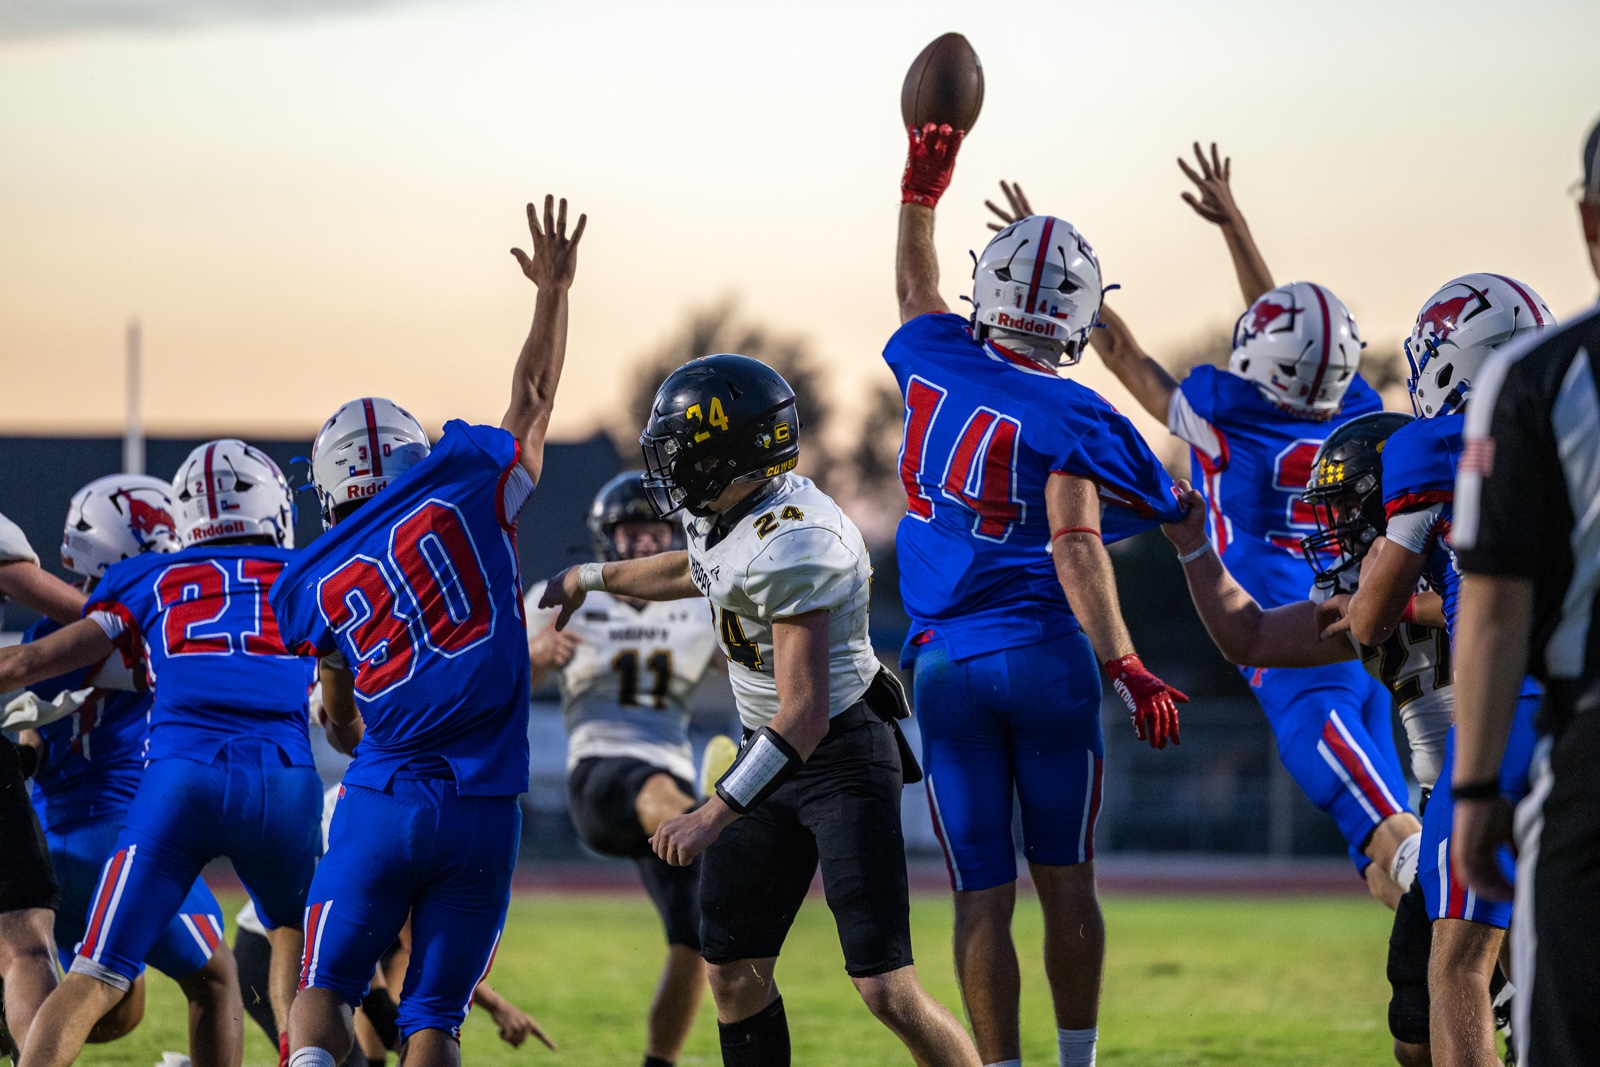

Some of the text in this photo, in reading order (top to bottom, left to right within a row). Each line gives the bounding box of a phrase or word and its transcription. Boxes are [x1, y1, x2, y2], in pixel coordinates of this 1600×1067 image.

[997, 312, 1056, 336] Riddell
[686, 396, 729, 443] 24
[774, 421, 790, 444] C
[897, 374, 1026, 543] 14
[191, 520, 245, 541] Riddell
[752, 505, 804, 540] 24
[153, 558, 299, 659] 21
[317, 498, 497, 702] 30
[709, 599, 765, 672] 4
[611, 647, 673, 711] 11
